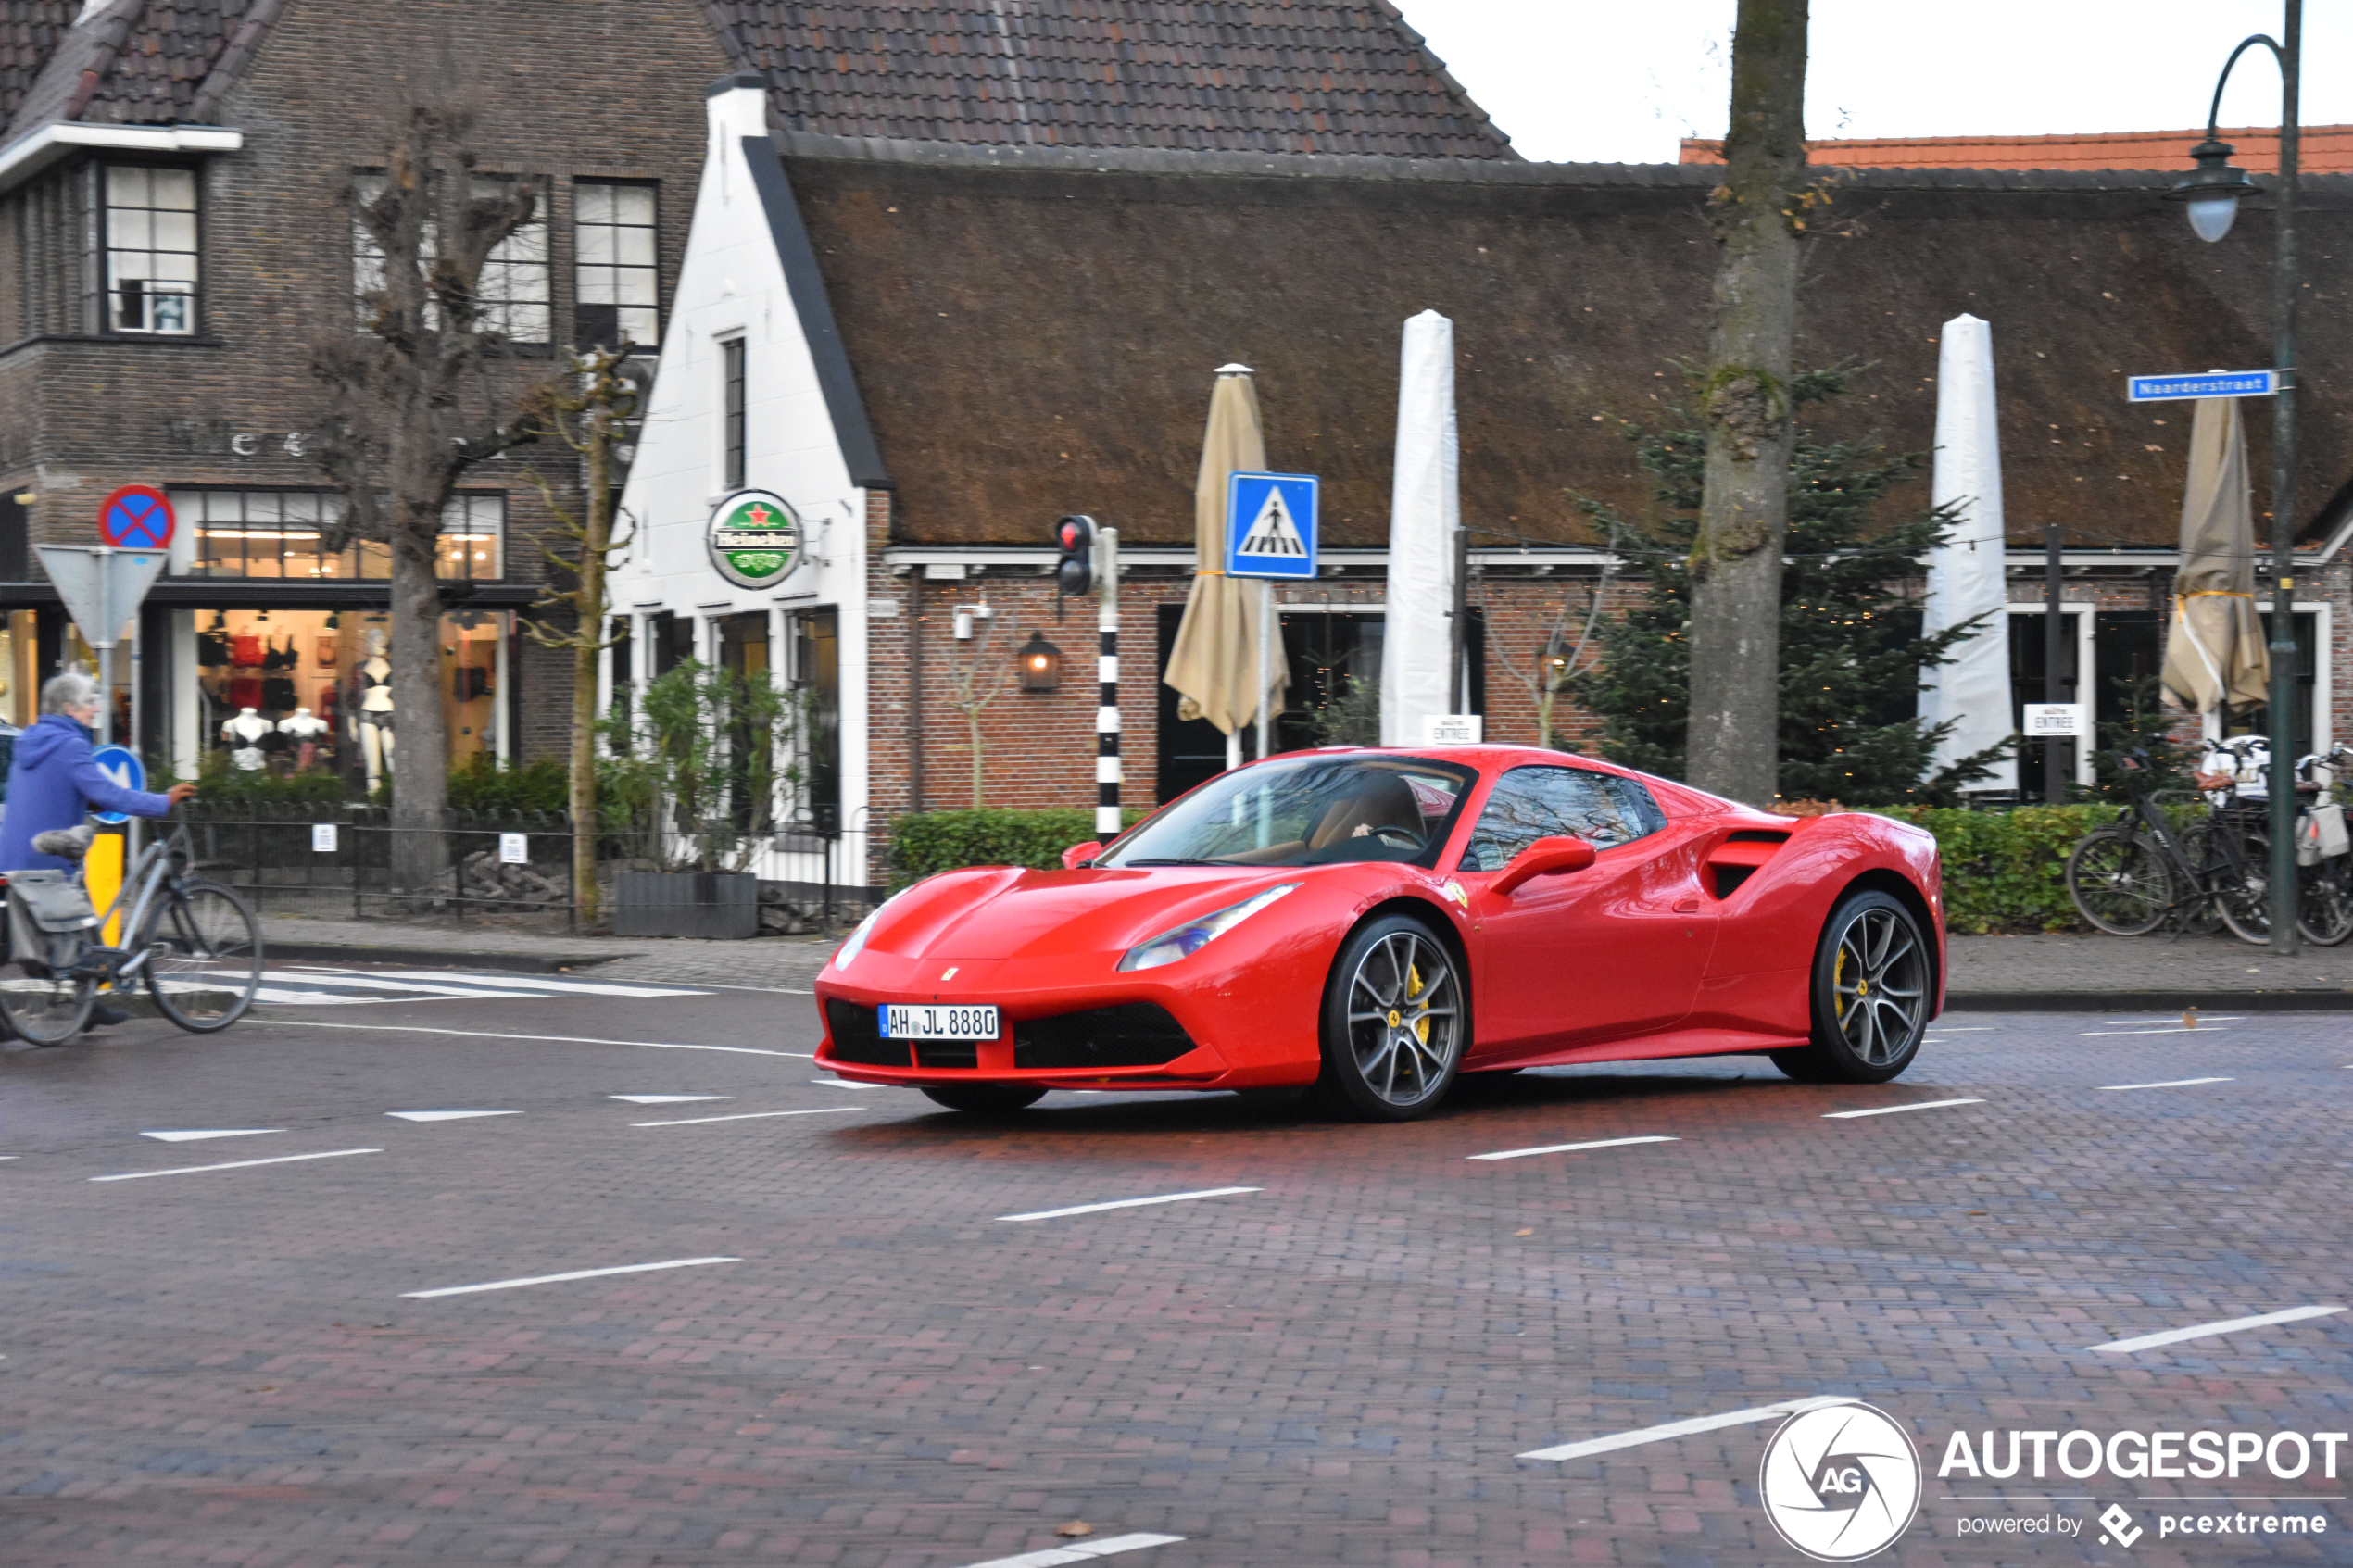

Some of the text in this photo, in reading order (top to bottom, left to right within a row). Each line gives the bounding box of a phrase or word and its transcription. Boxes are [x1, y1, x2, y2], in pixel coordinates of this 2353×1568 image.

[2138, 377, 2263, 395] Naarderstraat
[712, 532, 794, 546] Heineken
[890, 1009, 909, 1034] AH
[922, 1010, 943, 1035] JL
[949, 1010, 995, 1035] 8880
